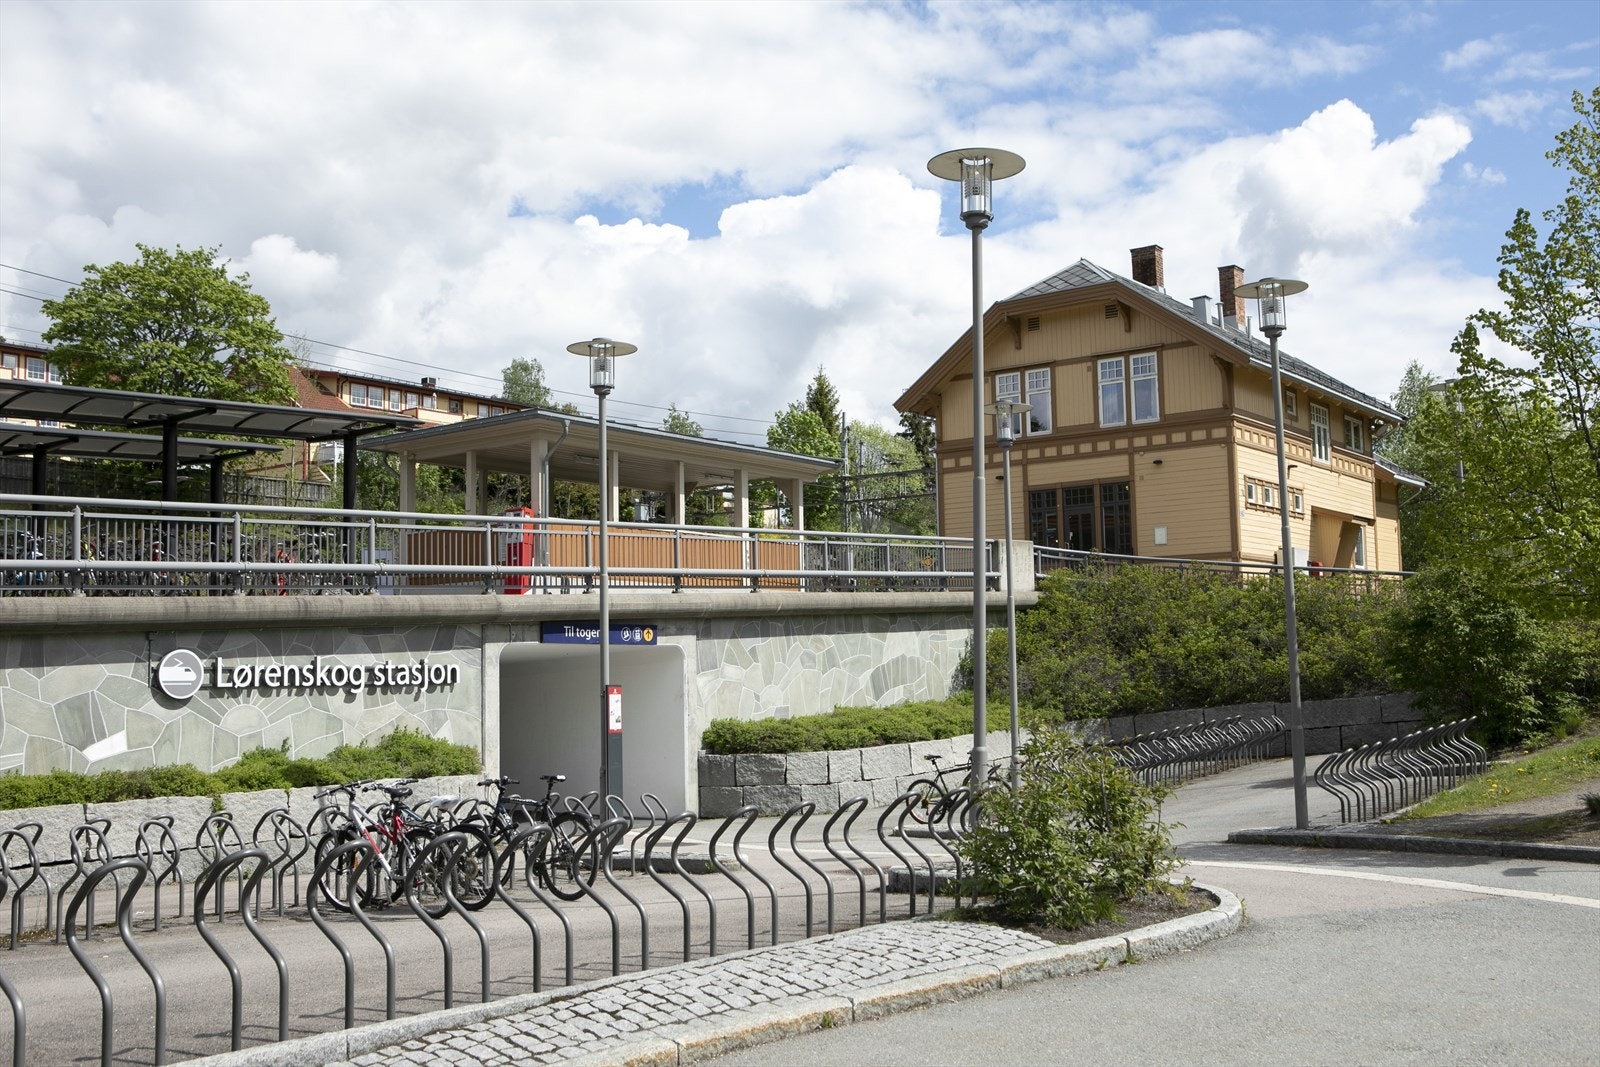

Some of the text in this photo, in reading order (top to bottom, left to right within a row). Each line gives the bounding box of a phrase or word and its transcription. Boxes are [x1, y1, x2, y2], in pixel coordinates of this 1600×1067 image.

[564, 626, 574, 637] Til
[217, 656, 460, 693] Lørenskog stasjon
